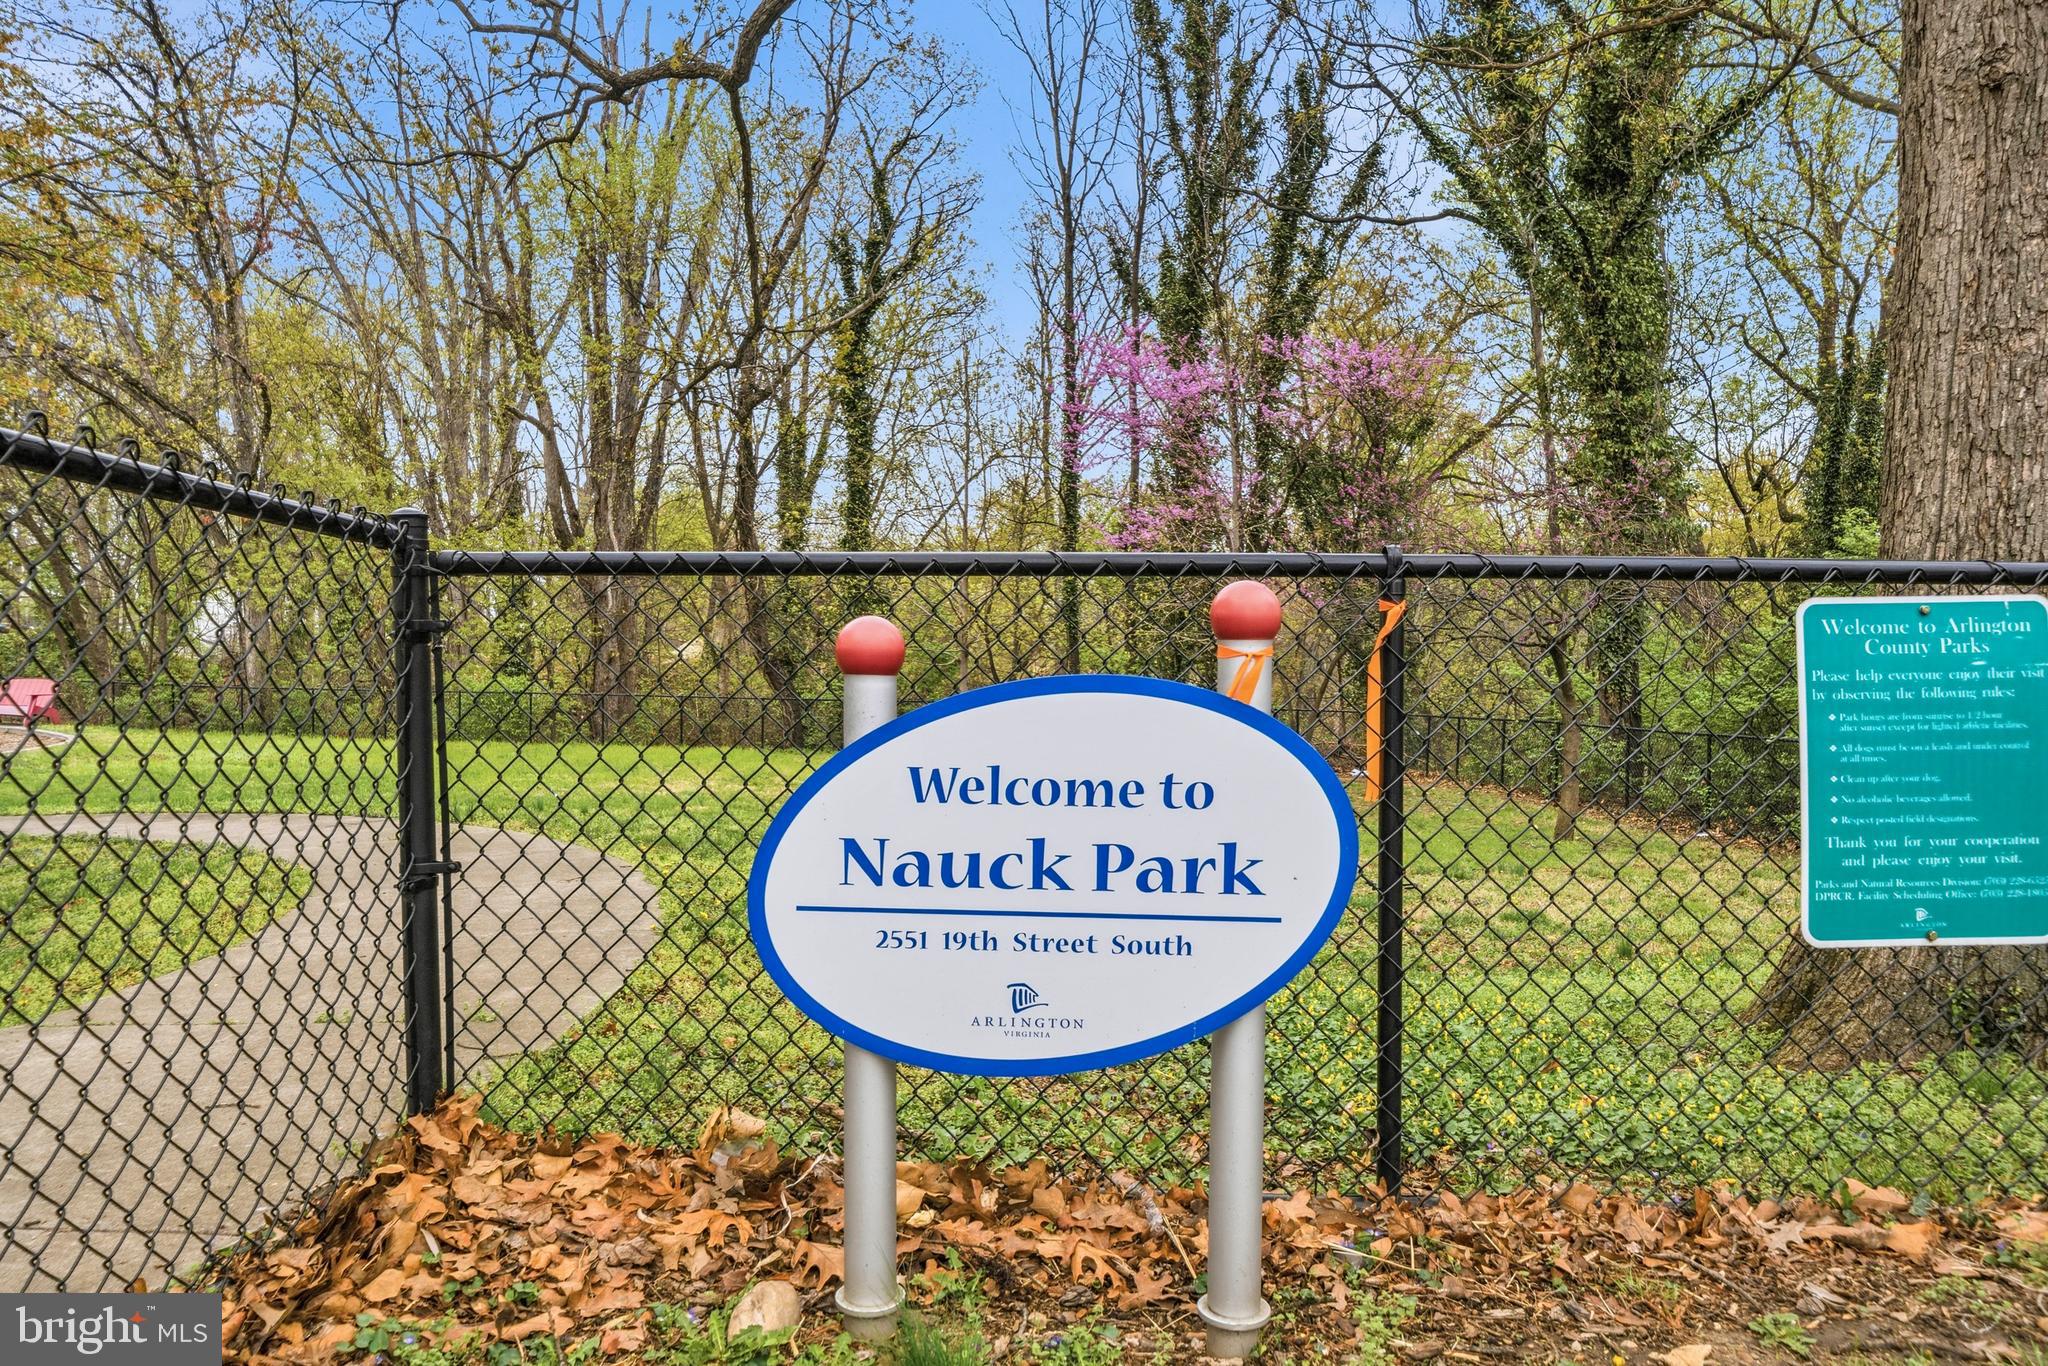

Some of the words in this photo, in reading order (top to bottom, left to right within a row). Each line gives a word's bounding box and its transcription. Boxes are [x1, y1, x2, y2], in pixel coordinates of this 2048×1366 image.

[1820, 617, 1910, 636] Welcome
[1917, 619, 1936, 635] to
[1944, 616, 2032, 636] Arlington
[1864, 638, 1931, 658] County
[1939, 636, 1990, 655] Parks
[1811, 669, 1850, 682] Please
[1856, 669, 1883, 683] help
[1888, 671, 1943, 684] everyone
[1949, 668, 1981, 683] enjoy
[1987, 667, 2016, 679] their
[2020, 667, 2045, 679] visit
[1812, 687, 1826, 702] by
[1832, 687, 1891, 702] observing
[1896, 687, 1916, 700] the
[1921, 686, 1977, 700] following
[1982, 684, 2016, 698] rules:
[1839, 712, 1858, 722] Park
[1861, 712, 1885, 721] hours
[1902, 711, 1923, 721] from
[1925, 711, 1953, 720] sunrise
[1840, 723, 1858, 732] after
[1860, 724, 1886, 732] sunset
[1888, 723, 1915, 733] except
[1917, 722, 1930, 731] for
[1932, 721, 1960, 731] lighted
[1840, 743, 1853, 752] All
[1854, 743, 1874, 753] dogs
[1876, 743, 1897, 752] must
[1899, 742, 1908, 751] be
[1931, 742, 1953, 751] leash
[1954, 741, 1971, 751] and
[1840, 774, 1865, 784] Clean
[1867, 775, 1879, 784] up
[1880, 774, 1899, 783] after
[1901, 775, 1920, 783] your
[908, 765, 1145, 810] Welcome
[1159, 772, 1215, 811] to
[1841, 795, 1855, 803] No
[1856, 794, 1893, 803] alcoholic
[1895, 793, 1937, 803] beverages
[1841, 815, 1874, 825] Respect
[1875, 815, 1904, 825] posted
[1905, 814, 1925, 823] field
[1824, 836, 1867, 849] Thank
[1874, 839, 1897, 850] you
[1903, 835, 1924, 847] for
[1929, 838, 1958, 849] your
[1964, 834, 2040, 847] cooperation
[838, 837, 1074, 891] Nauck
[1091, 842, 1266, 896] Park
[1841, 854, 1865, 866] and
[1872, 854, 1911, 868] please
[1918, 853, 1952, 867] enjoy
[1959, 855, 1986, 867] your
[1994, 851, 2023, 864] visit.
[1815, 880, 1839, 889] Parks
[1841, 880, 1858, 889] and
[1860, 879, 1894, 888] Natural
[1895, 878, 1940, 887] Resources
[1858, 891, 1888, 901] Facility
[1893, 890, 1943, 900] Scheduling
[1945, 889, 1977, 898] Office:
[875, 930, 929, 951] 2551
[942, 930, 998, 953] 19th
[1012, 932, 1098, 955] Street
[1110, 934, 1192, 957] South
[971, 1016, 1084, 1030] ARLINGTON
[1003, 1030, 1051, 1039] VIRGINIA
